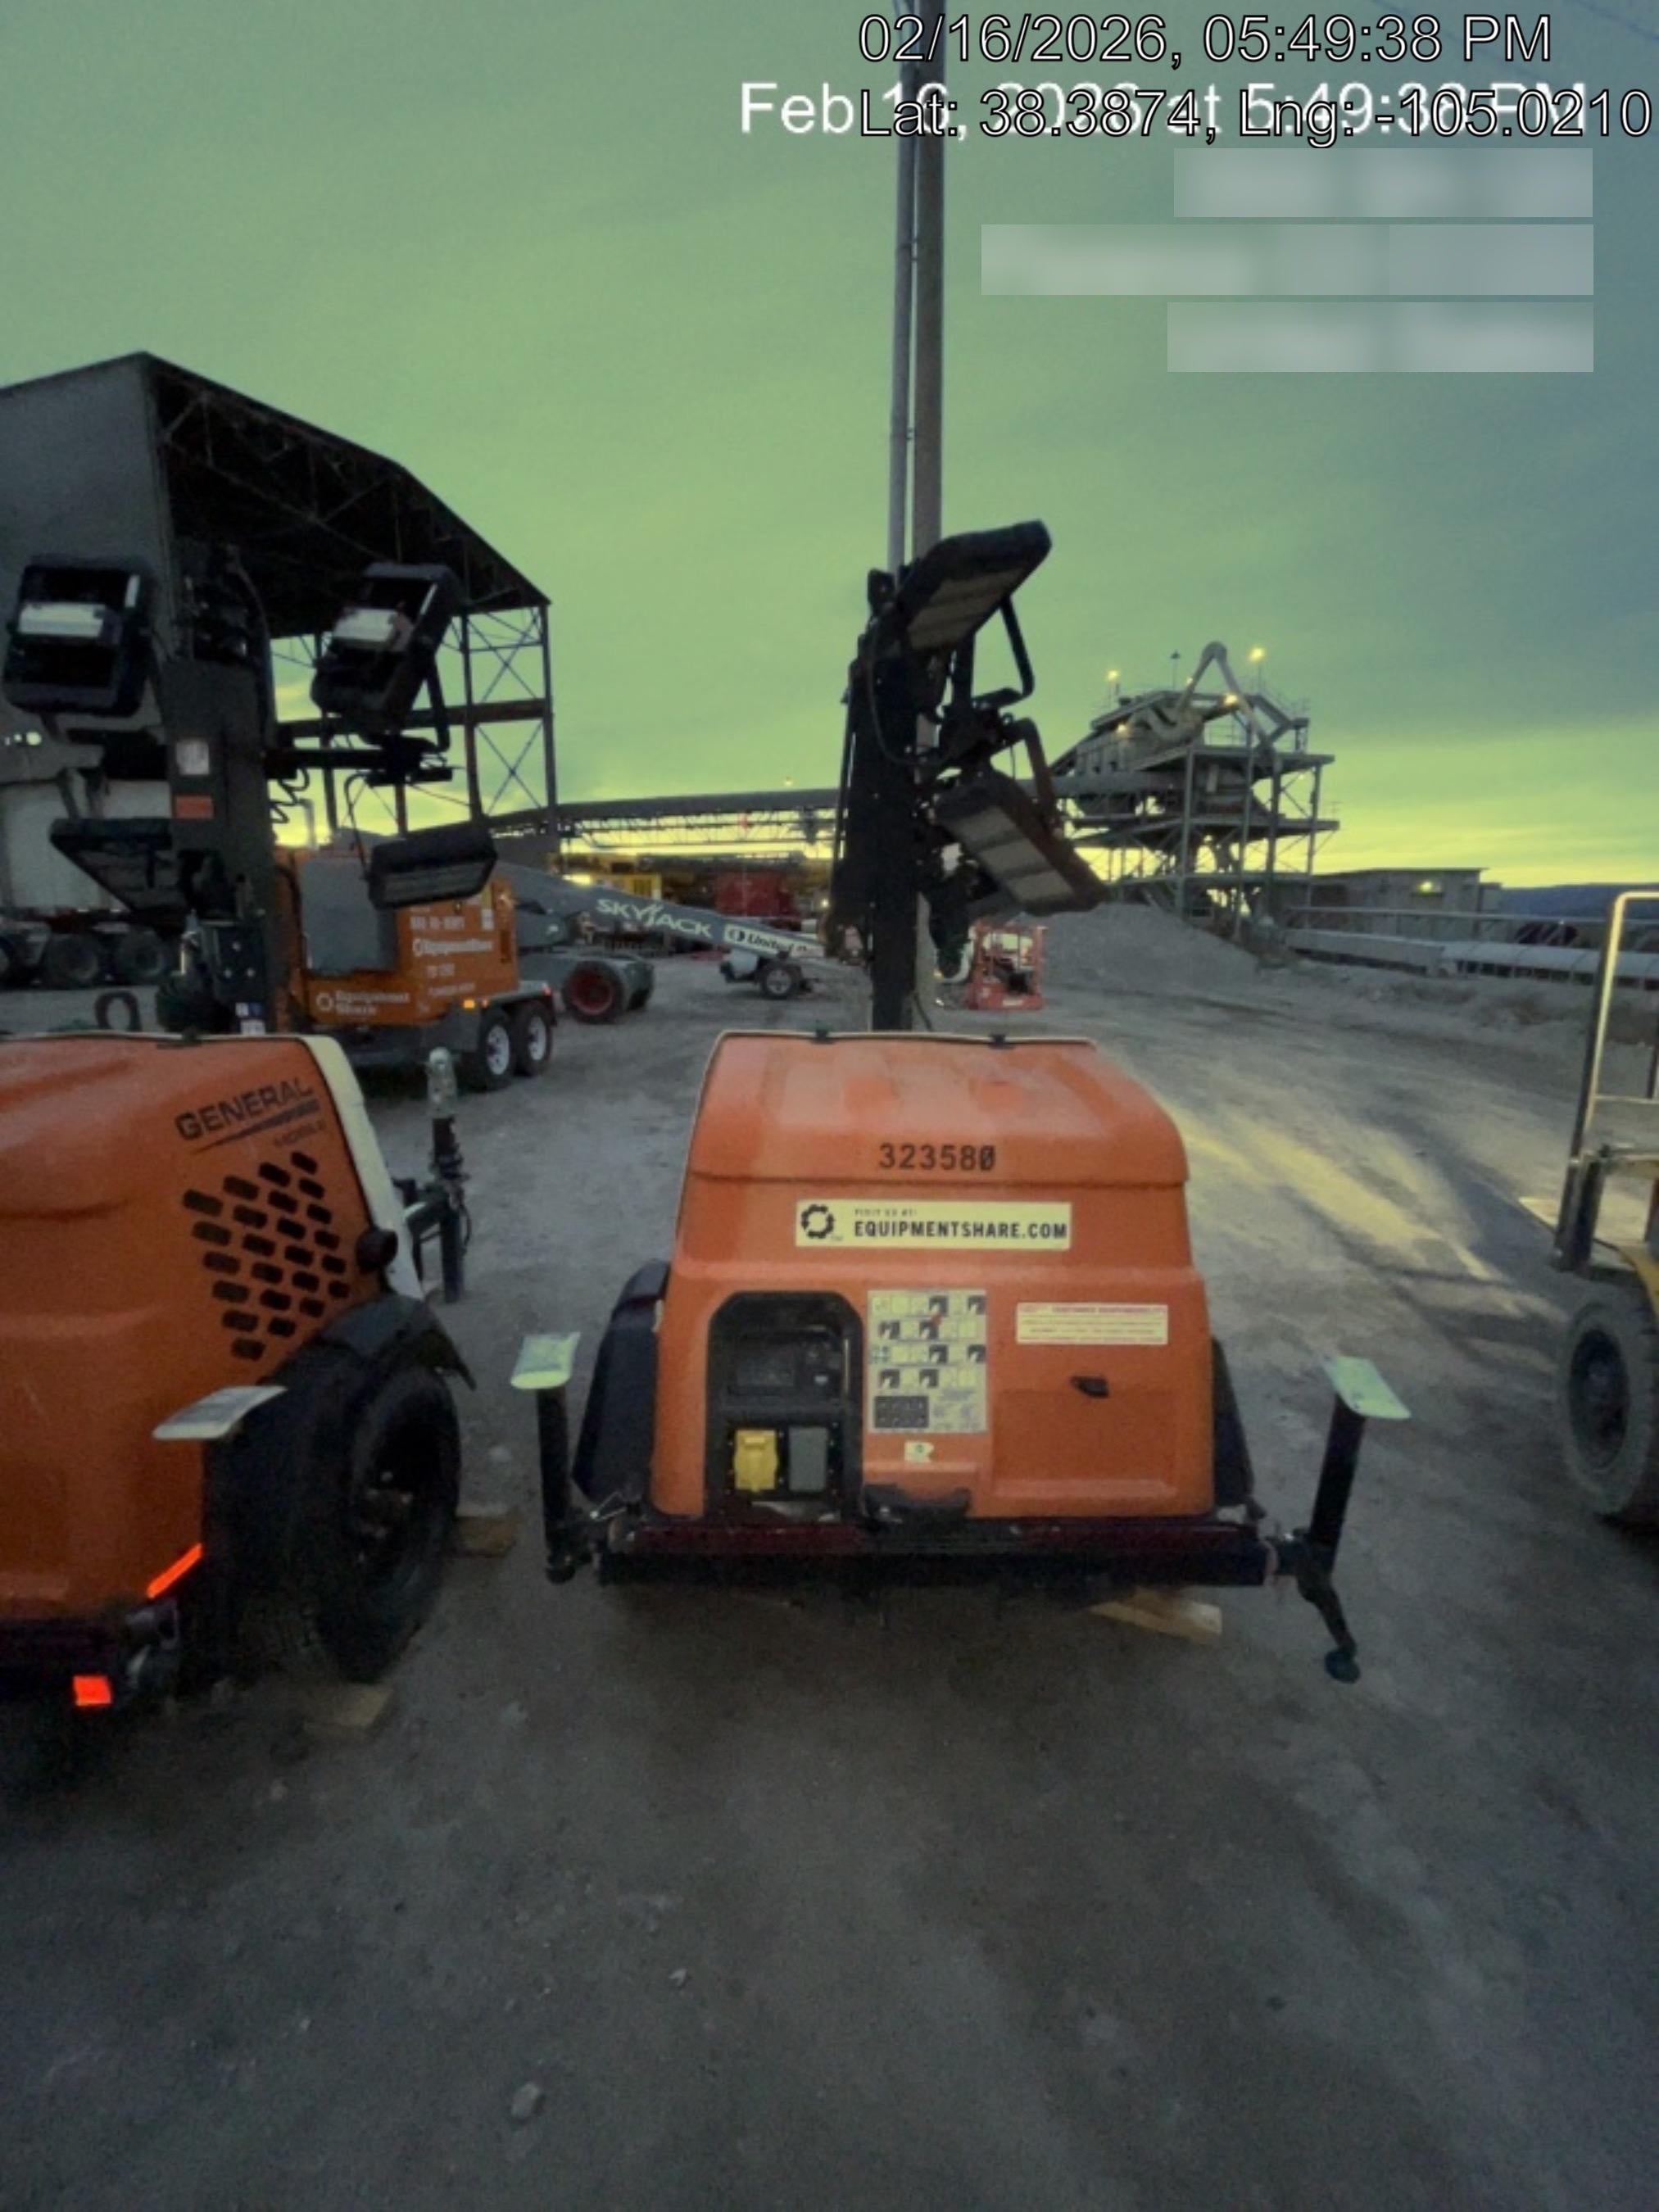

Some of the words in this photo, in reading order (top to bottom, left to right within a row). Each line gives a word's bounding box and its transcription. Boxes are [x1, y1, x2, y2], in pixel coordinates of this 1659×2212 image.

[596, 898, 714, 940] SKYJACK
[747, 932, 794, 952] Unitd
[173, 1077, 315, 1141] GENERAL
[879, 1142, 996, 1171] 323580
[854, 1220, 1067, 1240] EQUIPMENTSHARE.COM
